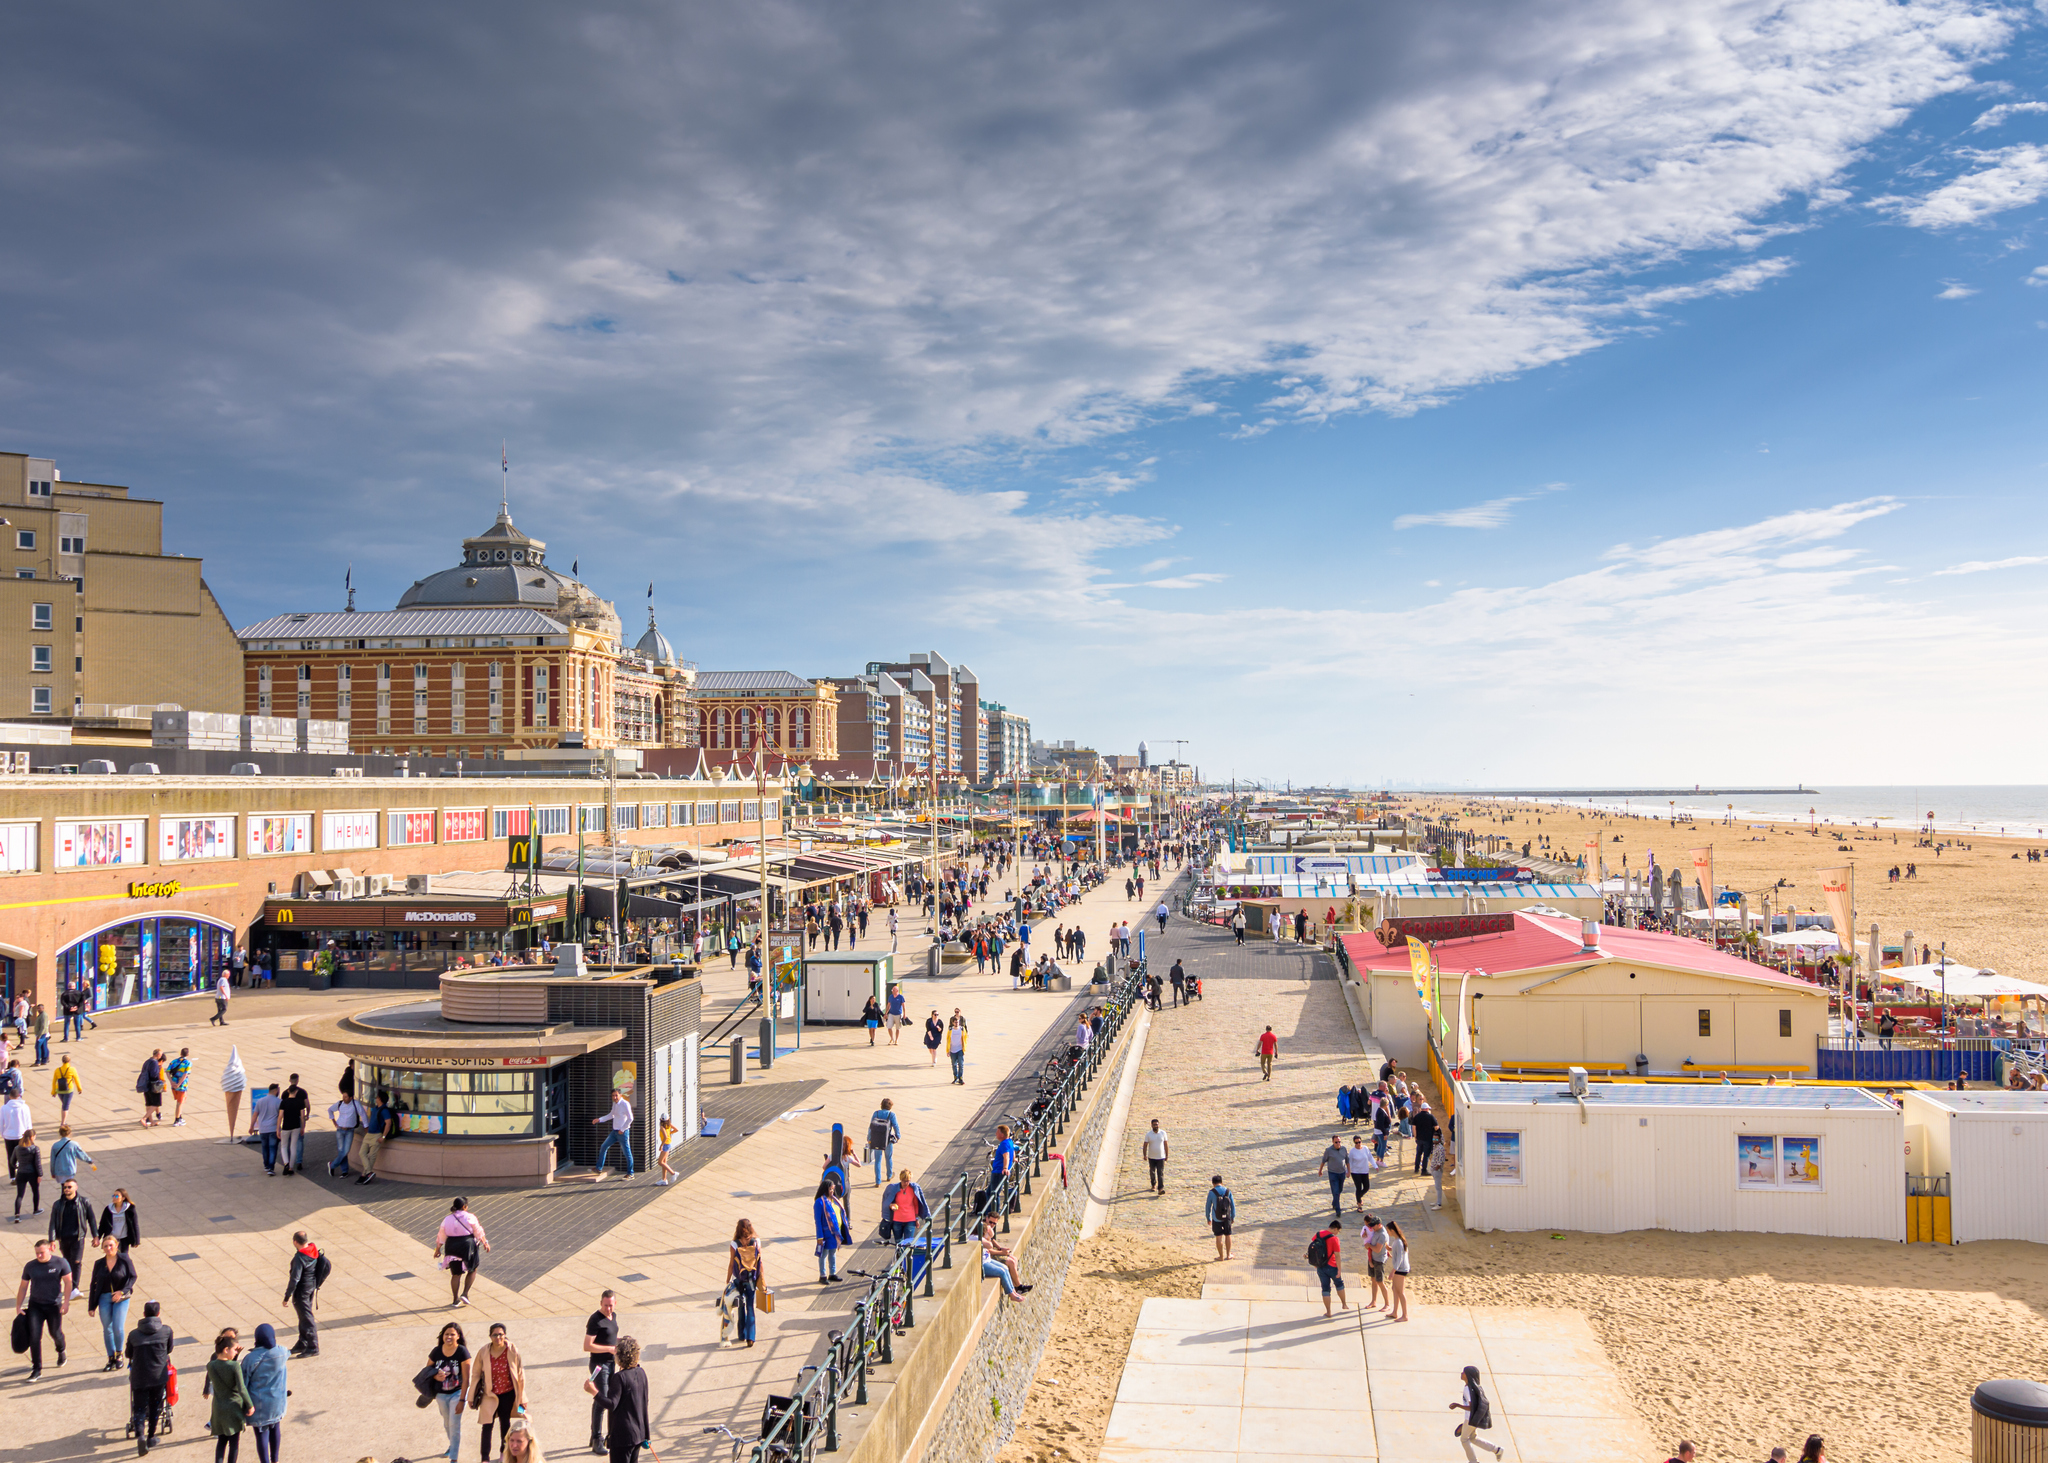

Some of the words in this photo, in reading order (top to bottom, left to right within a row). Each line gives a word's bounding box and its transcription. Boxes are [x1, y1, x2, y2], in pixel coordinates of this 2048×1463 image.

[336, 825, 370, 838] HEMA
[1447, 869, 1498, 880] SIMONIS
[130, 879, 181, 898] Intertoys
[405, 912, 476, 921] McDonald's
[1402, 920, 1454, 934] GRAND
[1460, 918, 1507, 932] PLAGE
